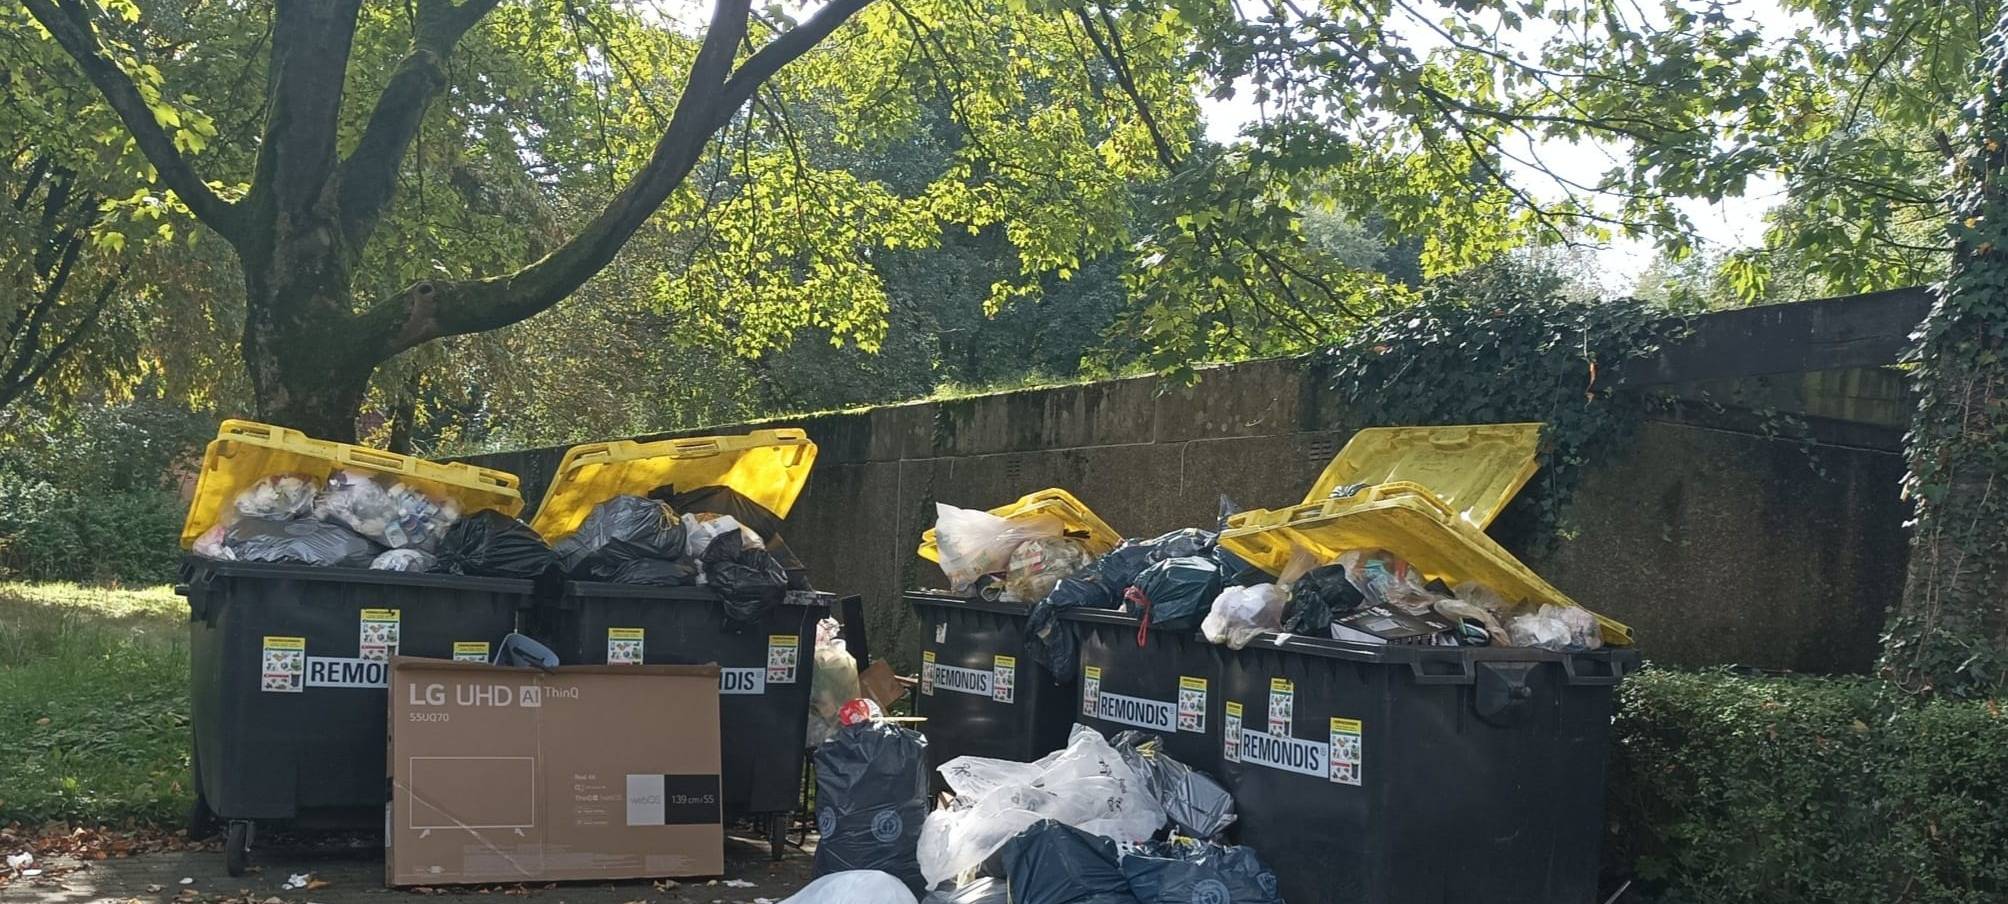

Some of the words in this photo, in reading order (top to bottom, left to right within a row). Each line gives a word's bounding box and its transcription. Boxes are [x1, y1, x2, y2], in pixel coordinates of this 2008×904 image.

[935, 667, 987, 692] REMONDIS
[409, 683, 446, 706] LG
[456, 684, 512, 707] UHD
[543, 686, 579, 699] ThinQ
[409, 712, 449, 722] 55UQ70
[1101, 696, 1169, 727] REMONDIS
[1243, 733, 1319, 771] REMONDIS
